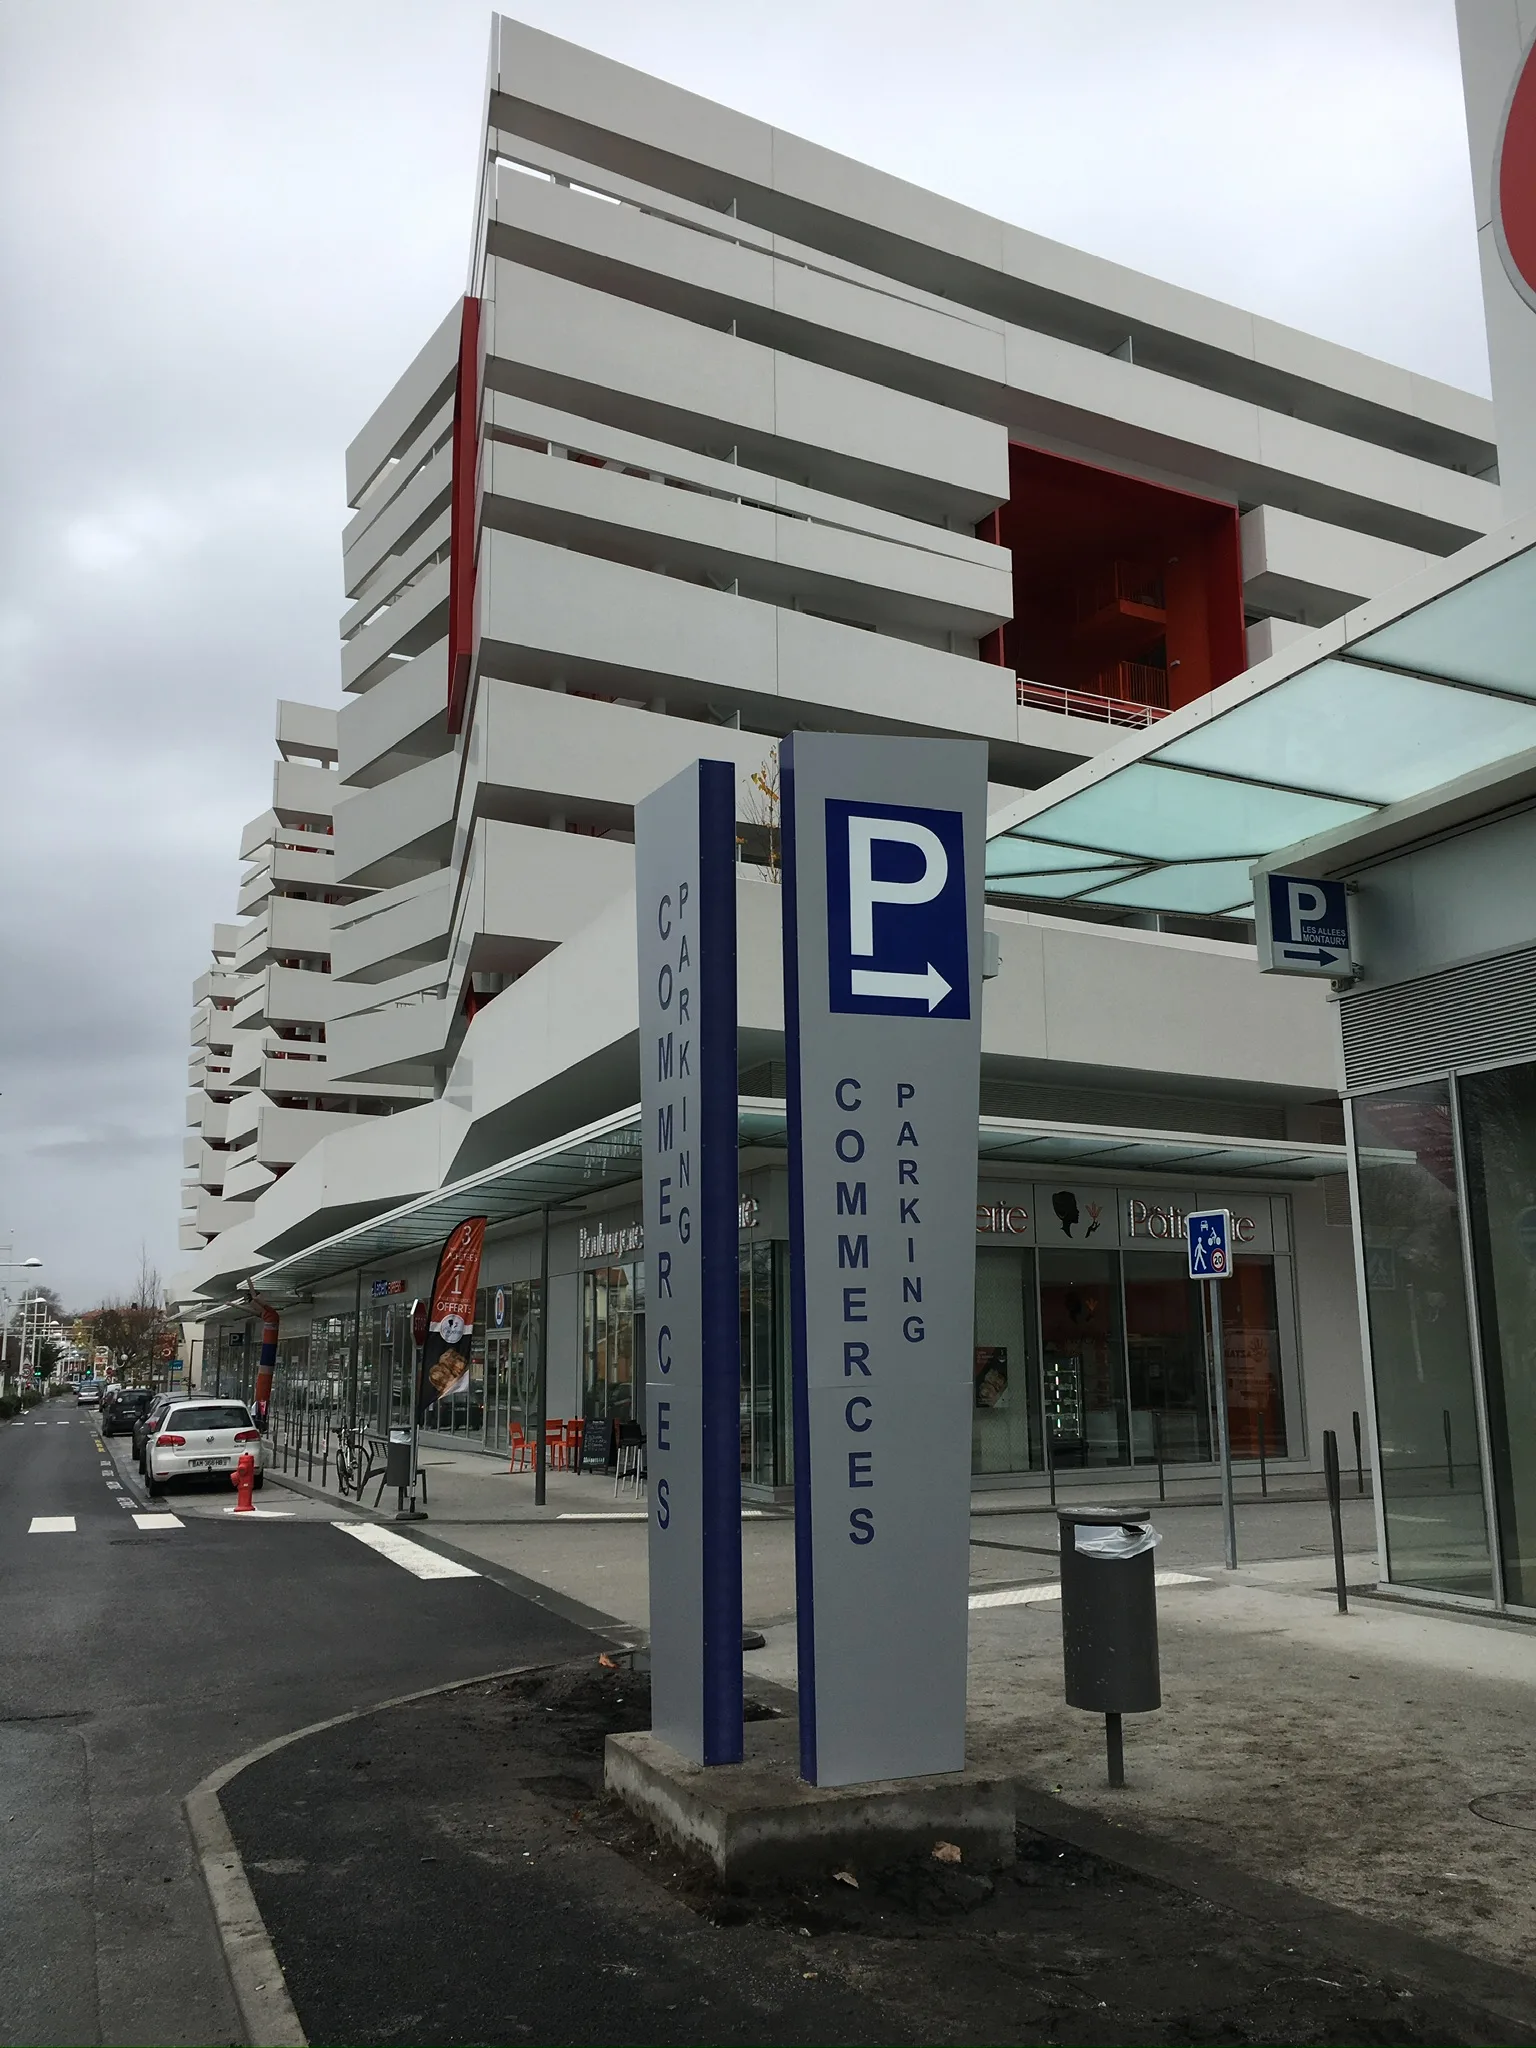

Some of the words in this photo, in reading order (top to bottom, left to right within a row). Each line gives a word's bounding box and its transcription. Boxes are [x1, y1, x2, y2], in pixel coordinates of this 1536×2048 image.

[848, 816, 949, 957] P
[1288, 882, 1327, 941] P
[1302, 926, 1317, 934] LES
[1318, 928, 1346, 937] ALLEES
[1302, 934, 1346, 945] MONTAURY
[677, 881, 691, 1244] PARKING
[656, 894, 674, 1530] COMMERCES
[896, 1083, 926, 1343] PARKING
[461, 1225, 472, 1246] 3
[1214, 1255, 1223, 1265] 20
[450, 1274, 462, 1295] 1
[436, 1301, 472, 1314] OFFERTE
[834, 1078, 875, 1546] COMMERCES
